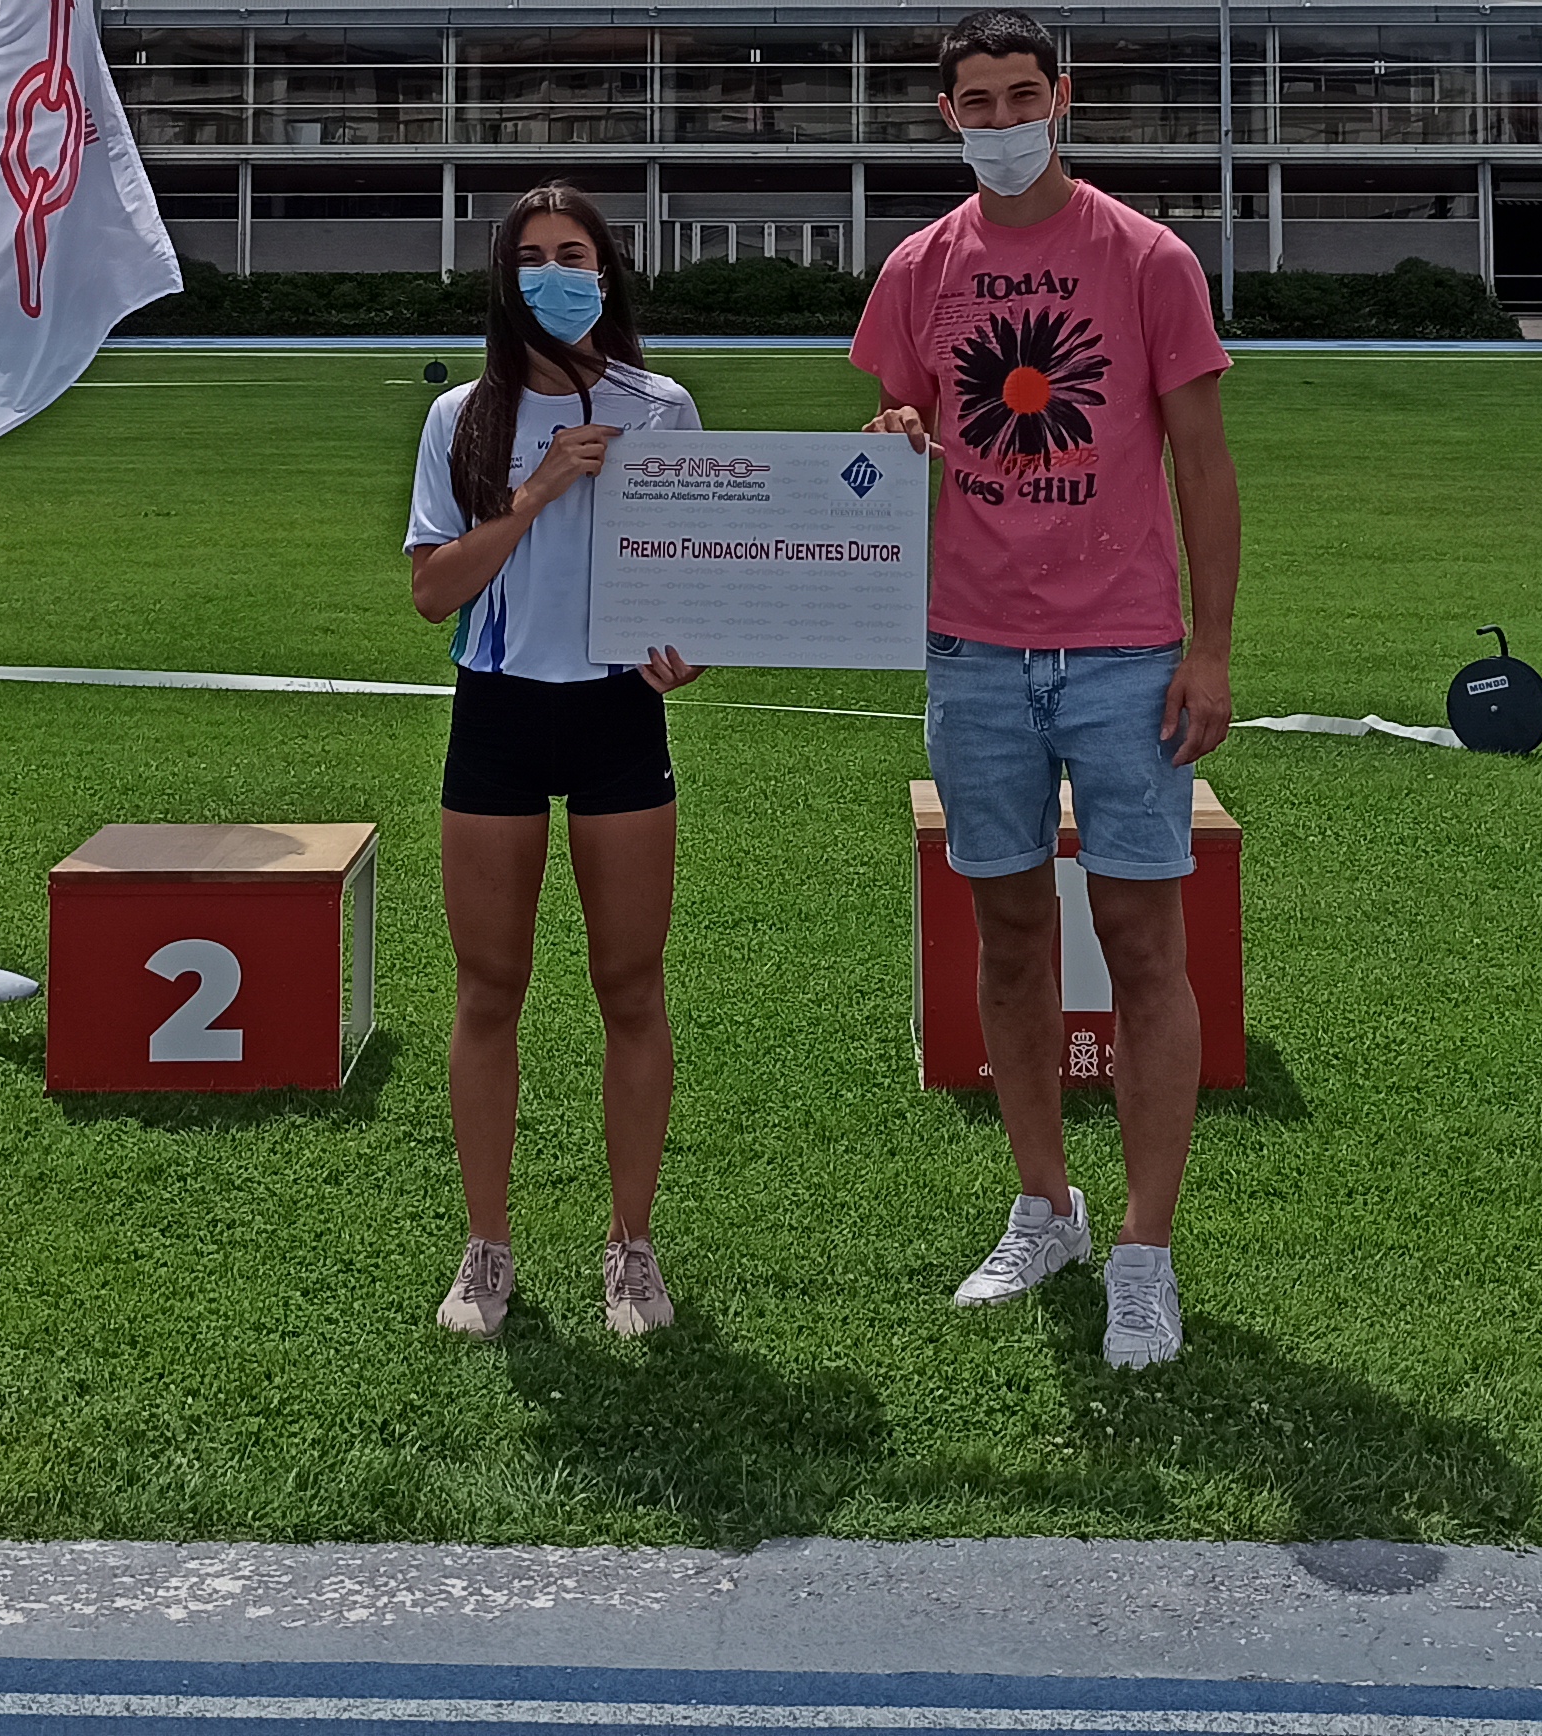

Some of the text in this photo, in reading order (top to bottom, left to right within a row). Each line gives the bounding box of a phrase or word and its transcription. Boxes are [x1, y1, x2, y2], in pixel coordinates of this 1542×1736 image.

[628, 478, 766, 489] Federación Navarra de Atletismo
[622, 491, 770, 501] Nafarroako Atletismo Federakuntza
[619, 536, 901, 563] PREMIO FUNDACIÓN FUENTES DUTOR
[1469, 678, 1507, 693] MONDO
[144, 938, 243, 1062] 2
